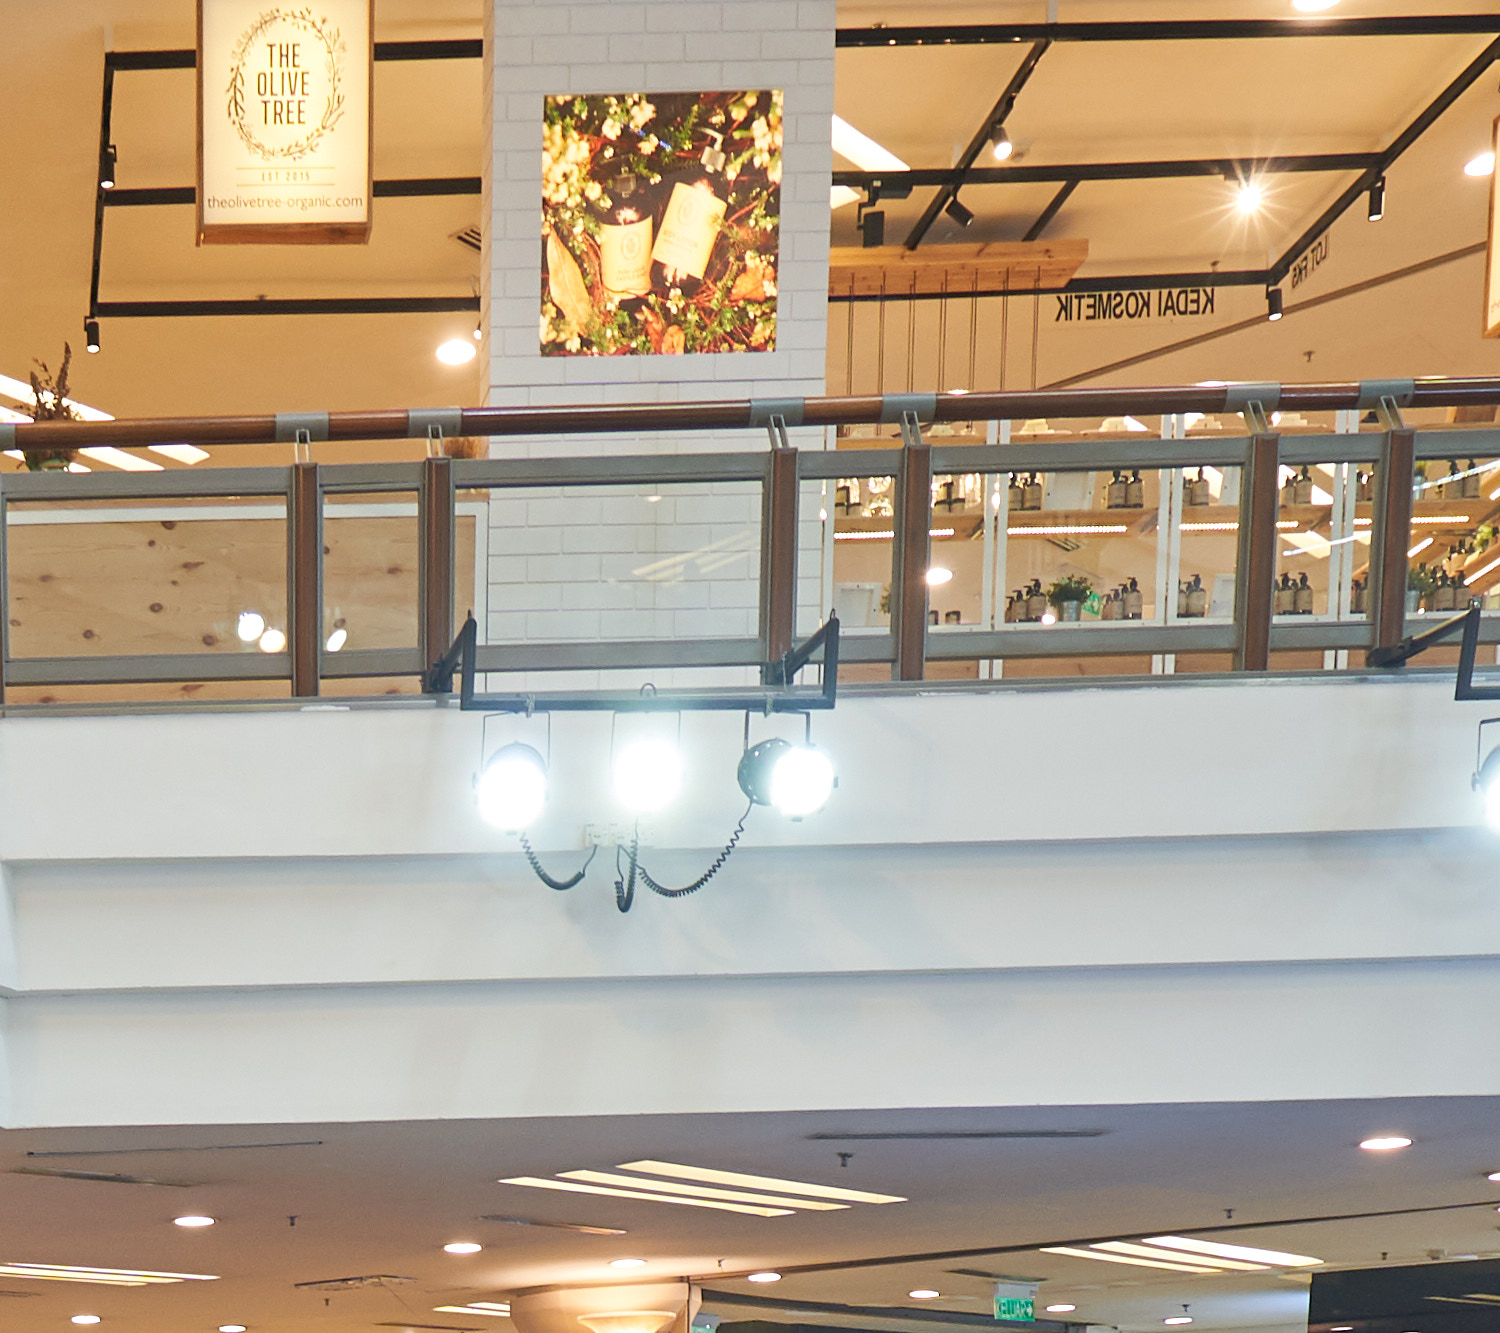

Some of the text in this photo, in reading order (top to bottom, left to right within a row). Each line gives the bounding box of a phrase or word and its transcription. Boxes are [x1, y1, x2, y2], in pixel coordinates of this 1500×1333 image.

[266, 43, 300, 68] THE
[257, 71, 310, 96] OLIVE
[261, 100, 305, 125] TREE
[207, 195, 363, 210] theolivetree-organic.com
